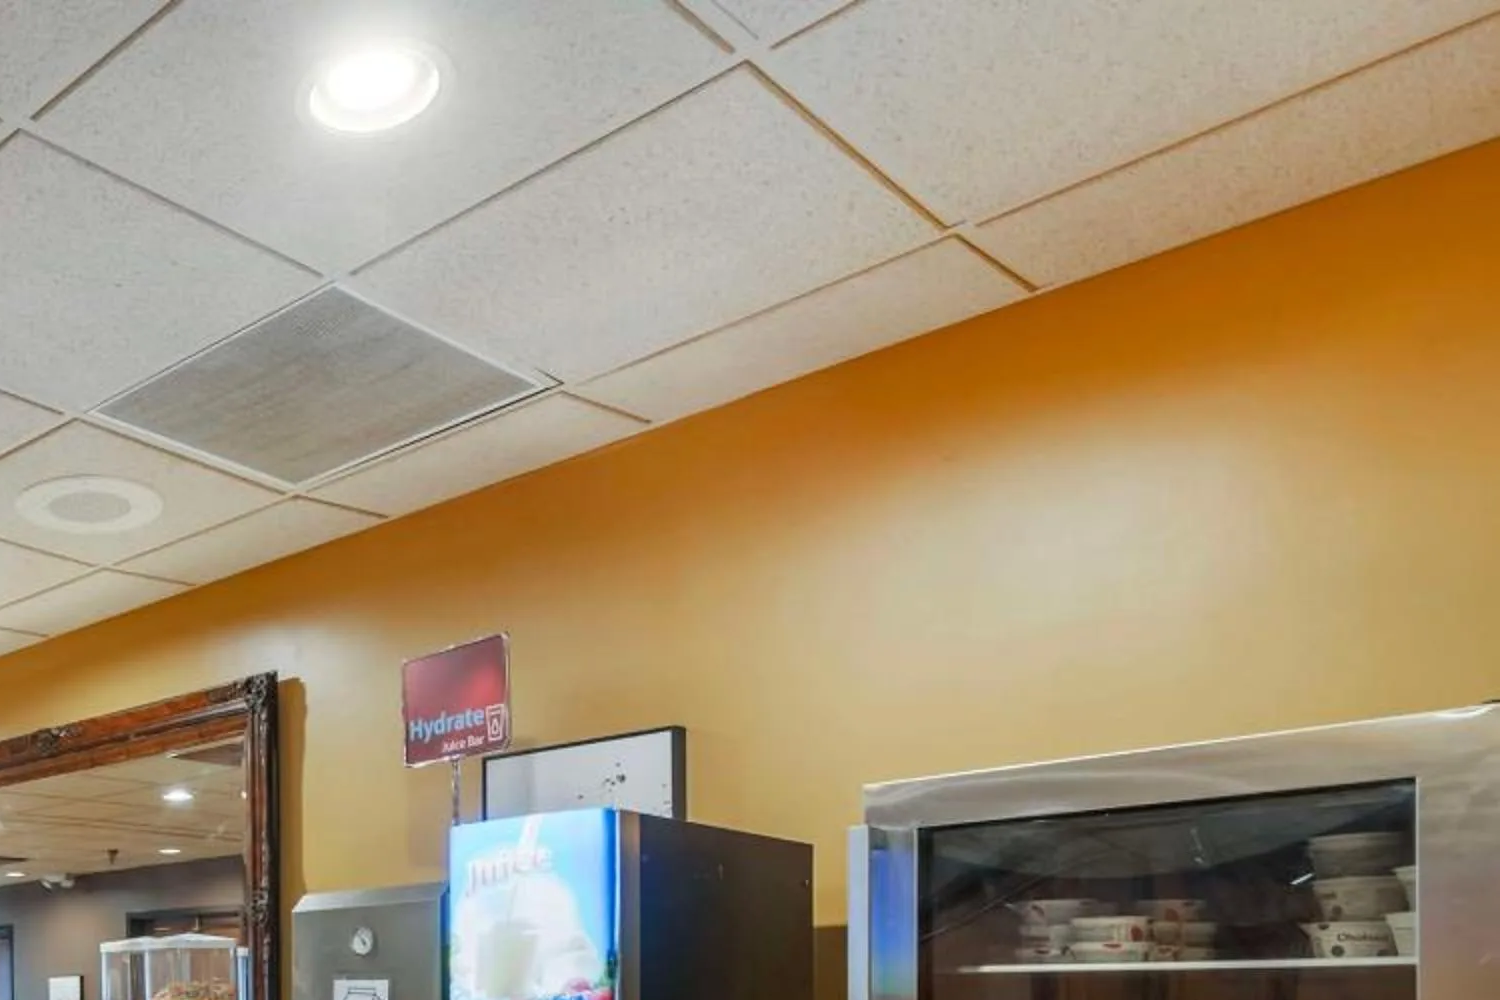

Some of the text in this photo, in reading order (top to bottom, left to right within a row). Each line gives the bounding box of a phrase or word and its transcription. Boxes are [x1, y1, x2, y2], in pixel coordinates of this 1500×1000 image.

[409, 708, 485, 744] Hydrate
[442, 735, 485, 753] Juice Bar
